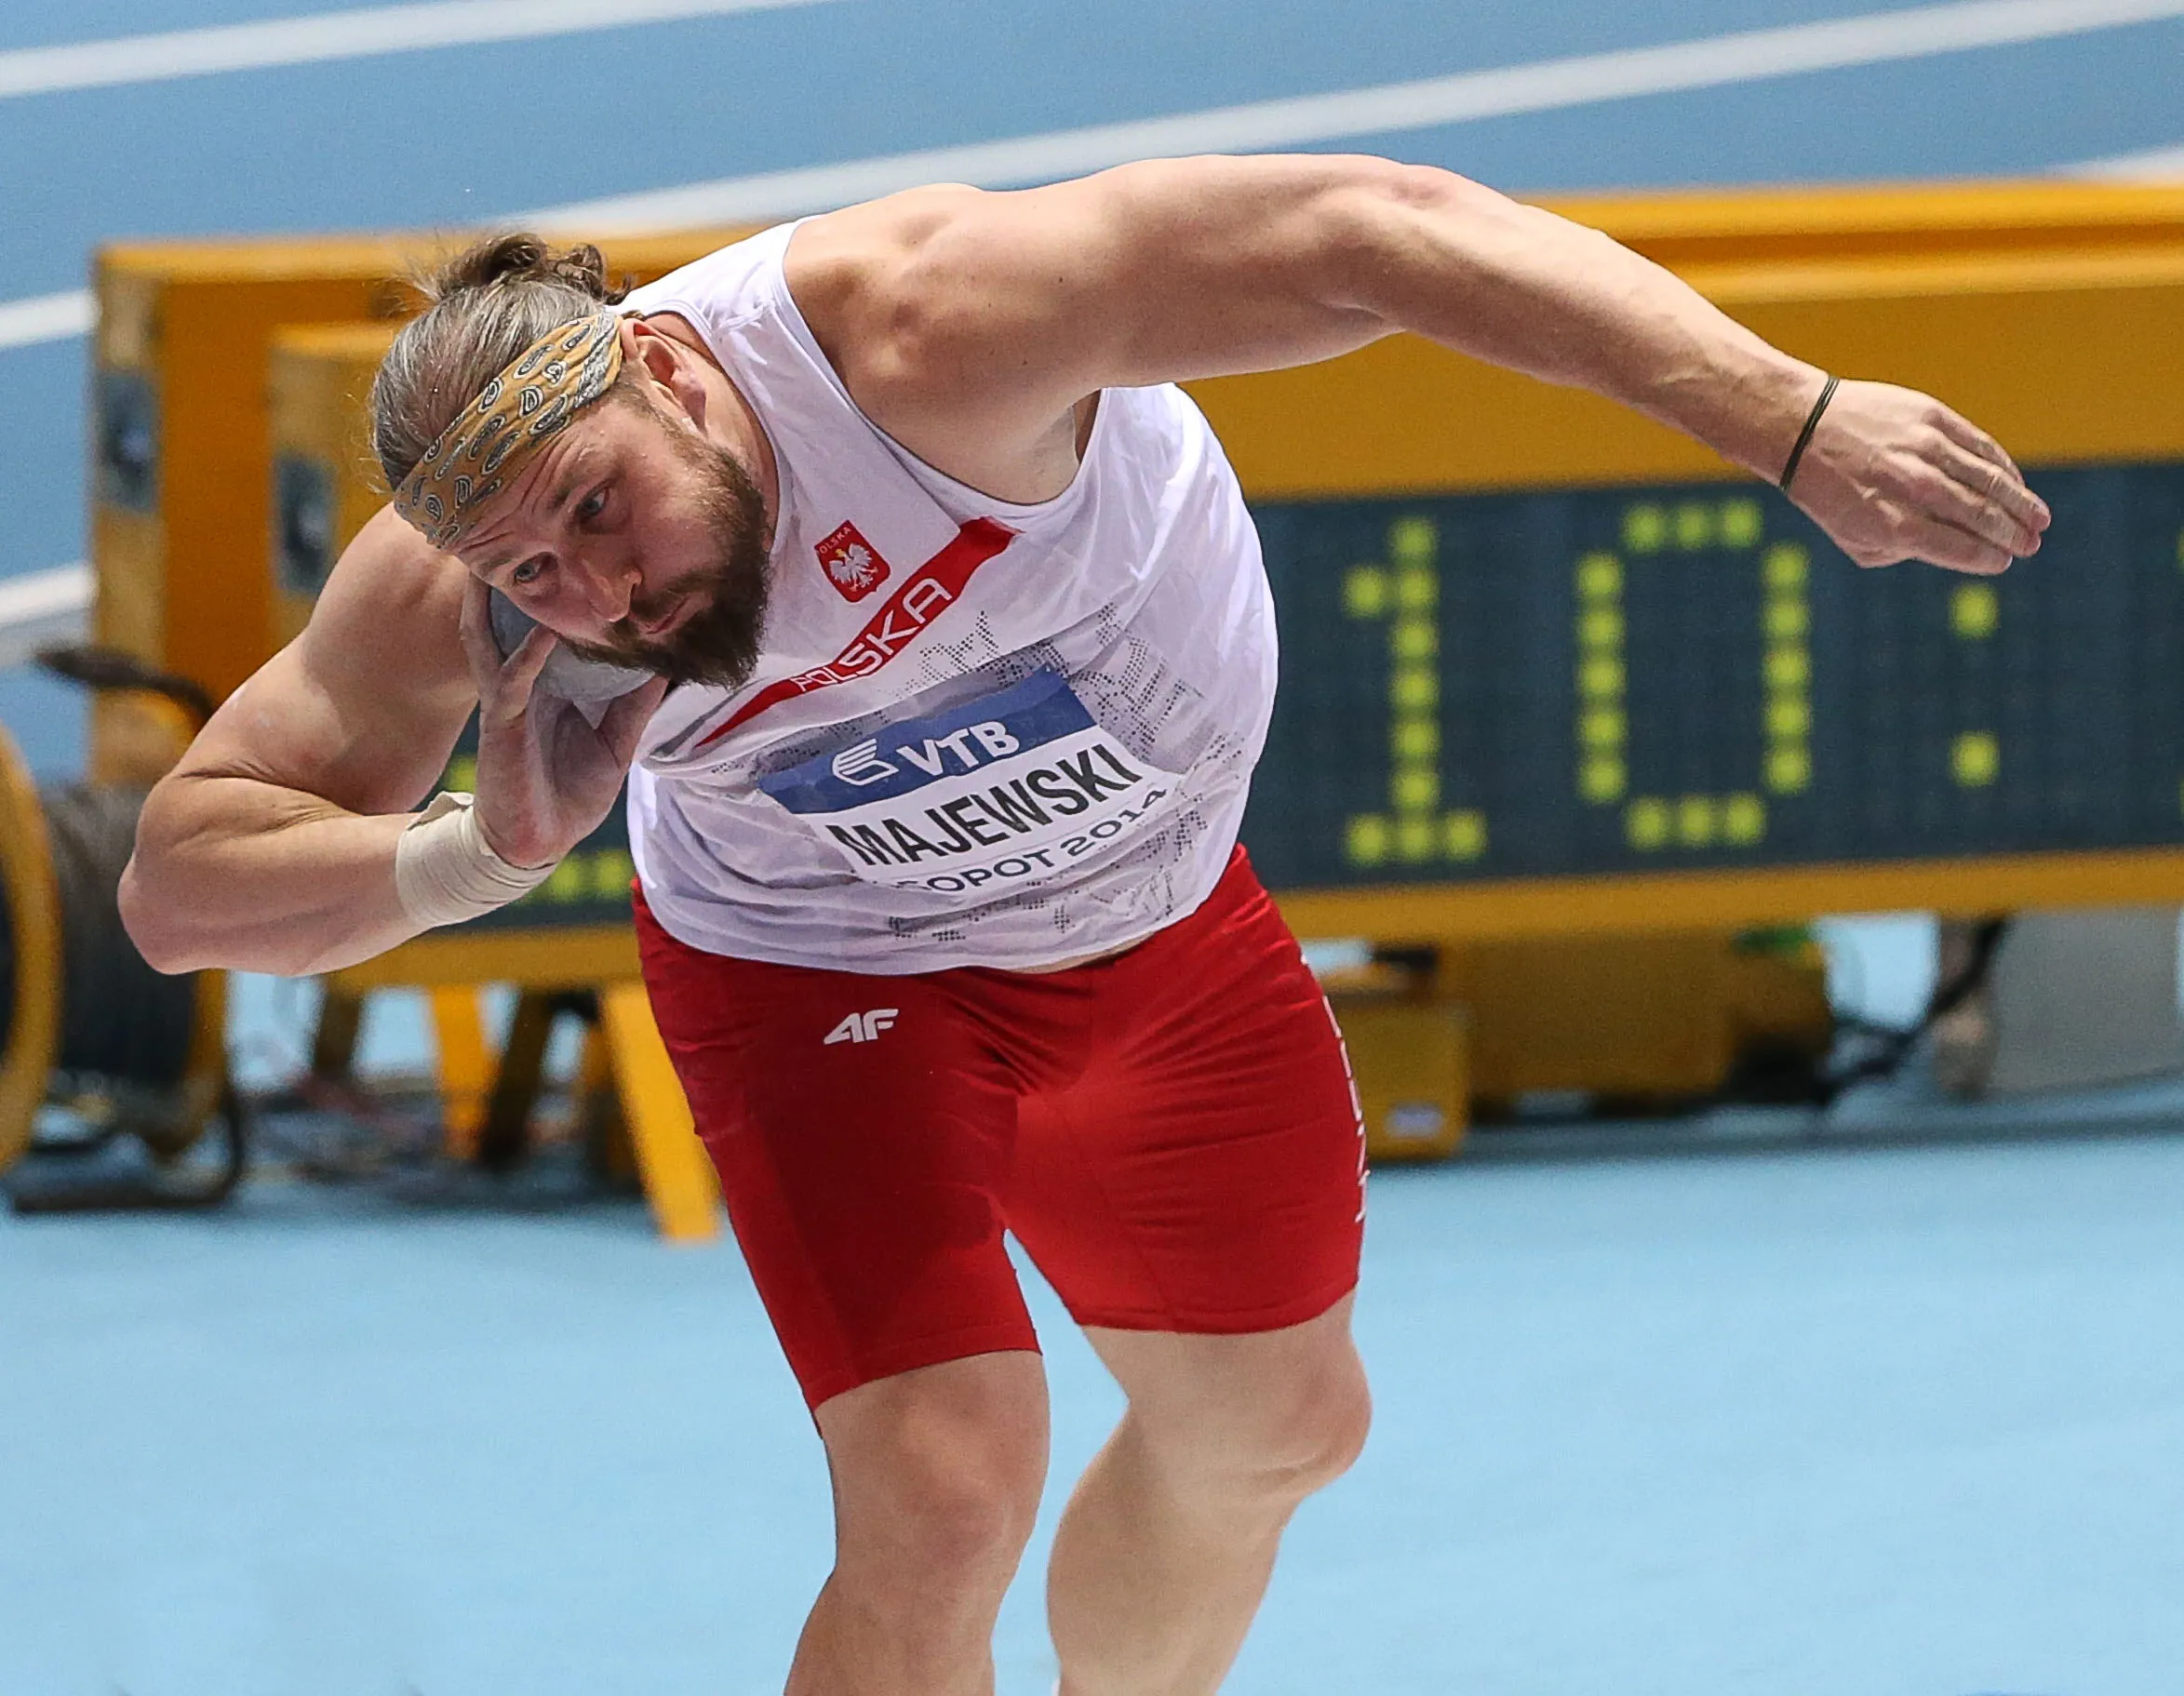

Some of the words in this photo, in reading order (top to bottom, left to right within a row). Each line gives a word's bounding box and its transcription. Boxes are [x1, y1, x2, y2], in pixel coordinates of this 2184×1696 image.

[819, 527, 851, 554] OLSKA
[789, 578, 953, 692] POLSKA
[896, 721, 1019, 775] VTB
[825, 744, 1143, 865] MAJEWSKI
[1060, 789, 1167, 857] 2014
